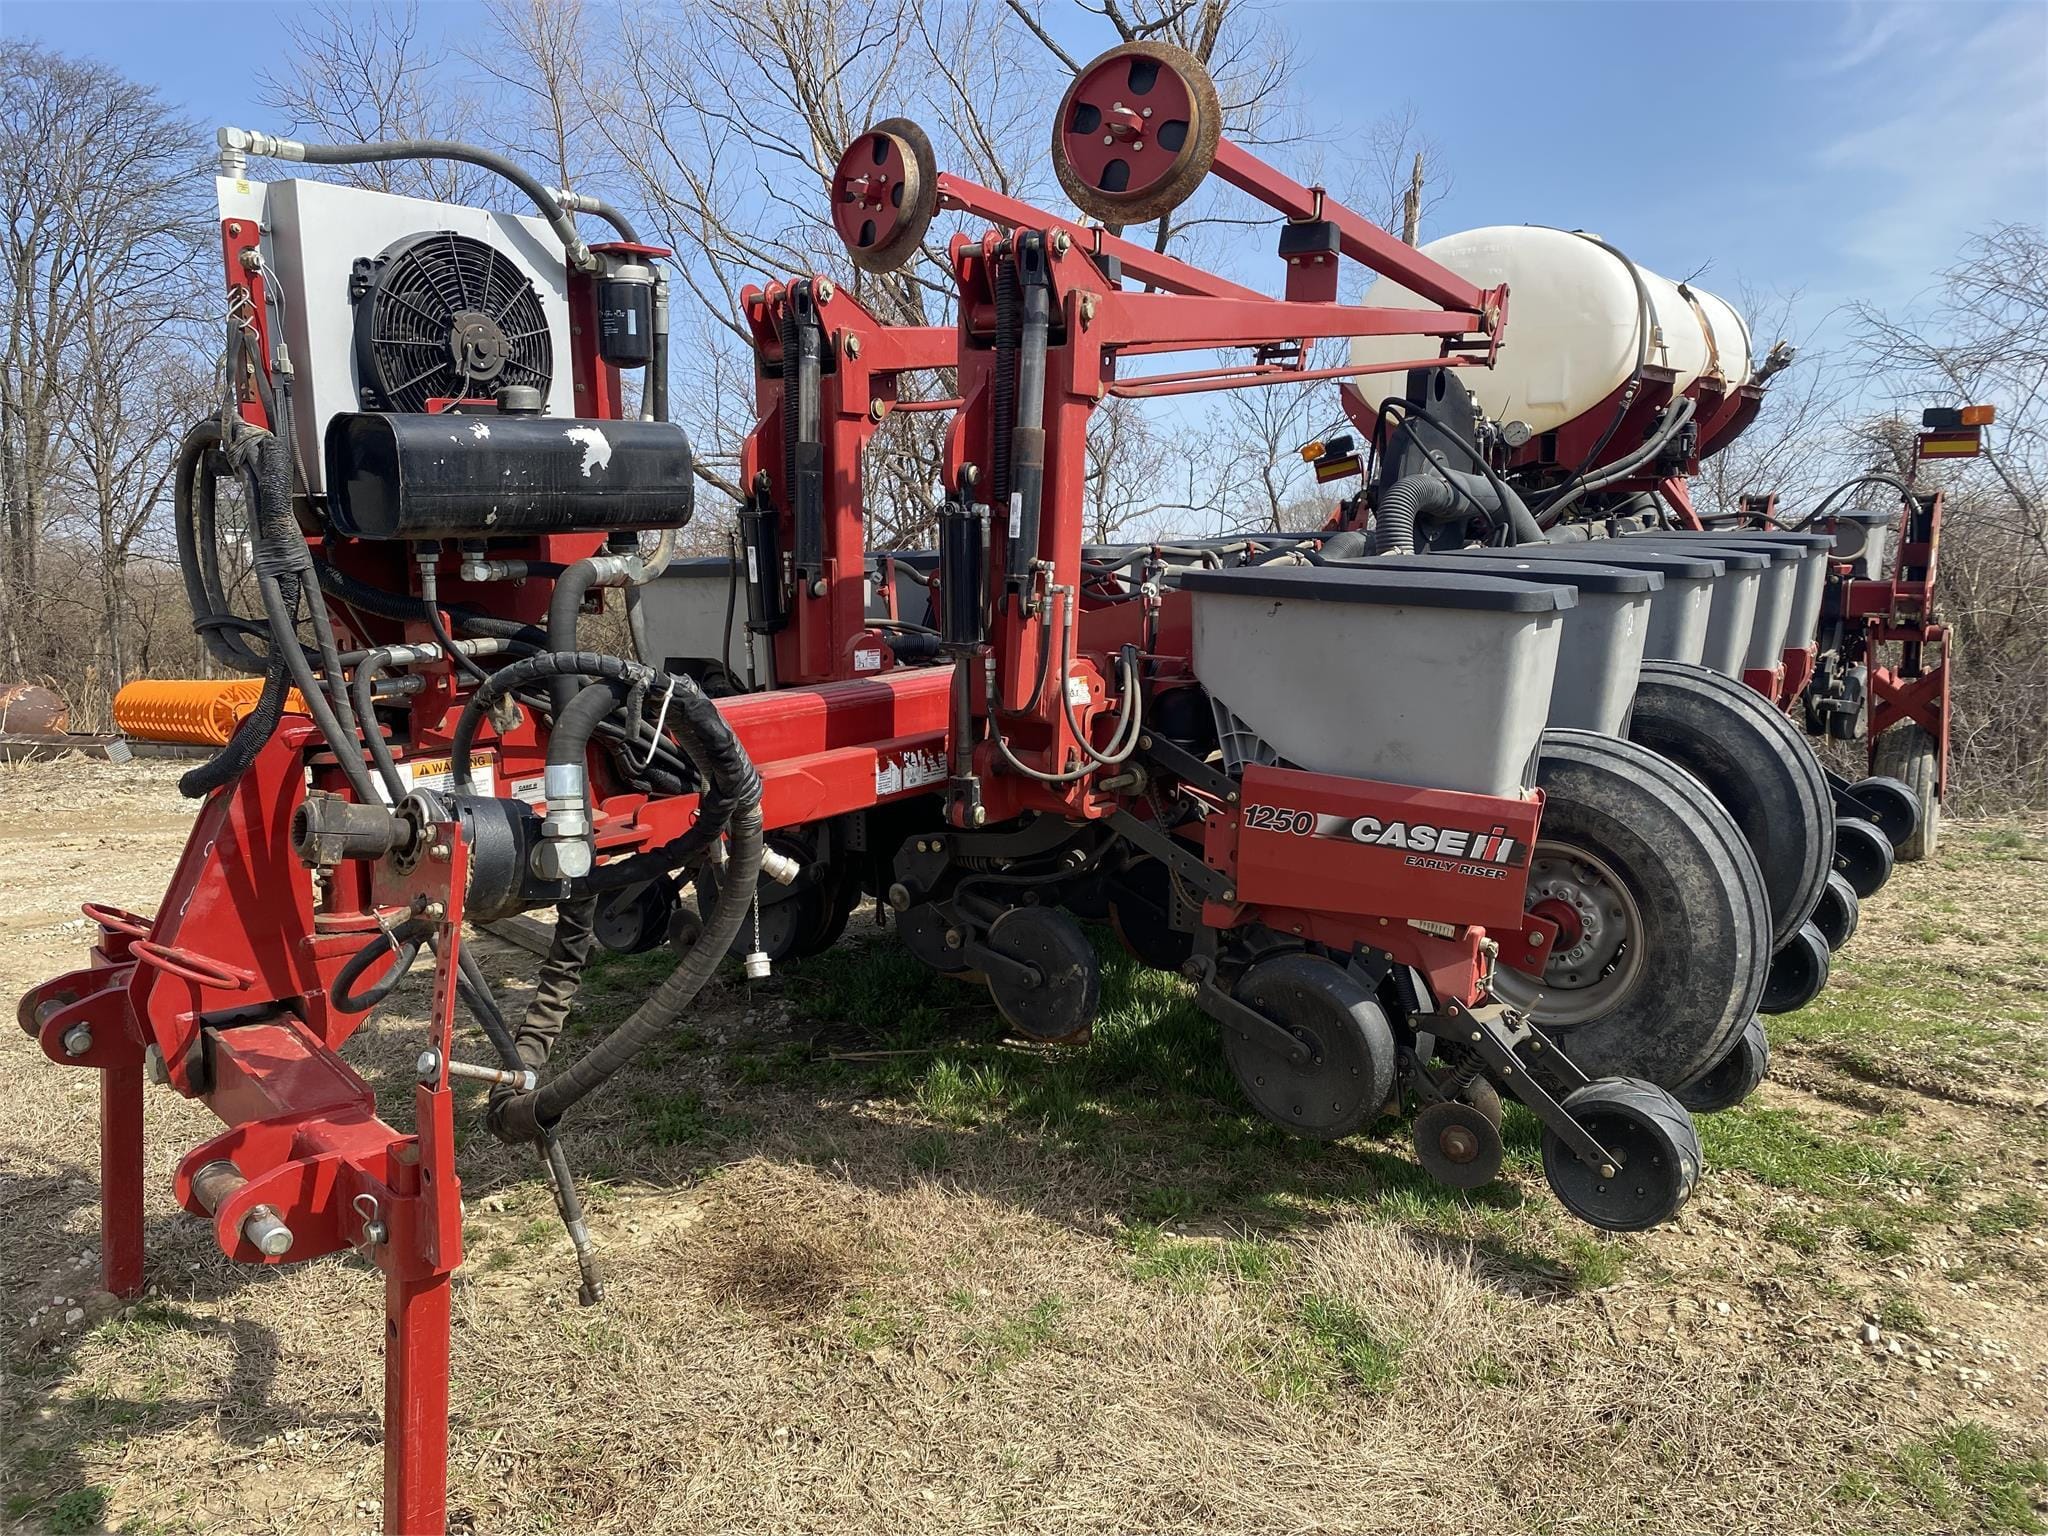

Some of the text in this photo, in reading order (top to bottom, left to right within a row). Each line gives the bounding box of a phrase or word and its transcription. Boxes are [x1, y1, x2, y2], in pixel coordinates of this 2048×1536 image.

[431, 756, 486, 773] WANG
[1243, 804, 1314, 836] 1250
[1351, 817, 1469, 857] CASE
[1405, 856, 1507, 880] EARLY RISER
